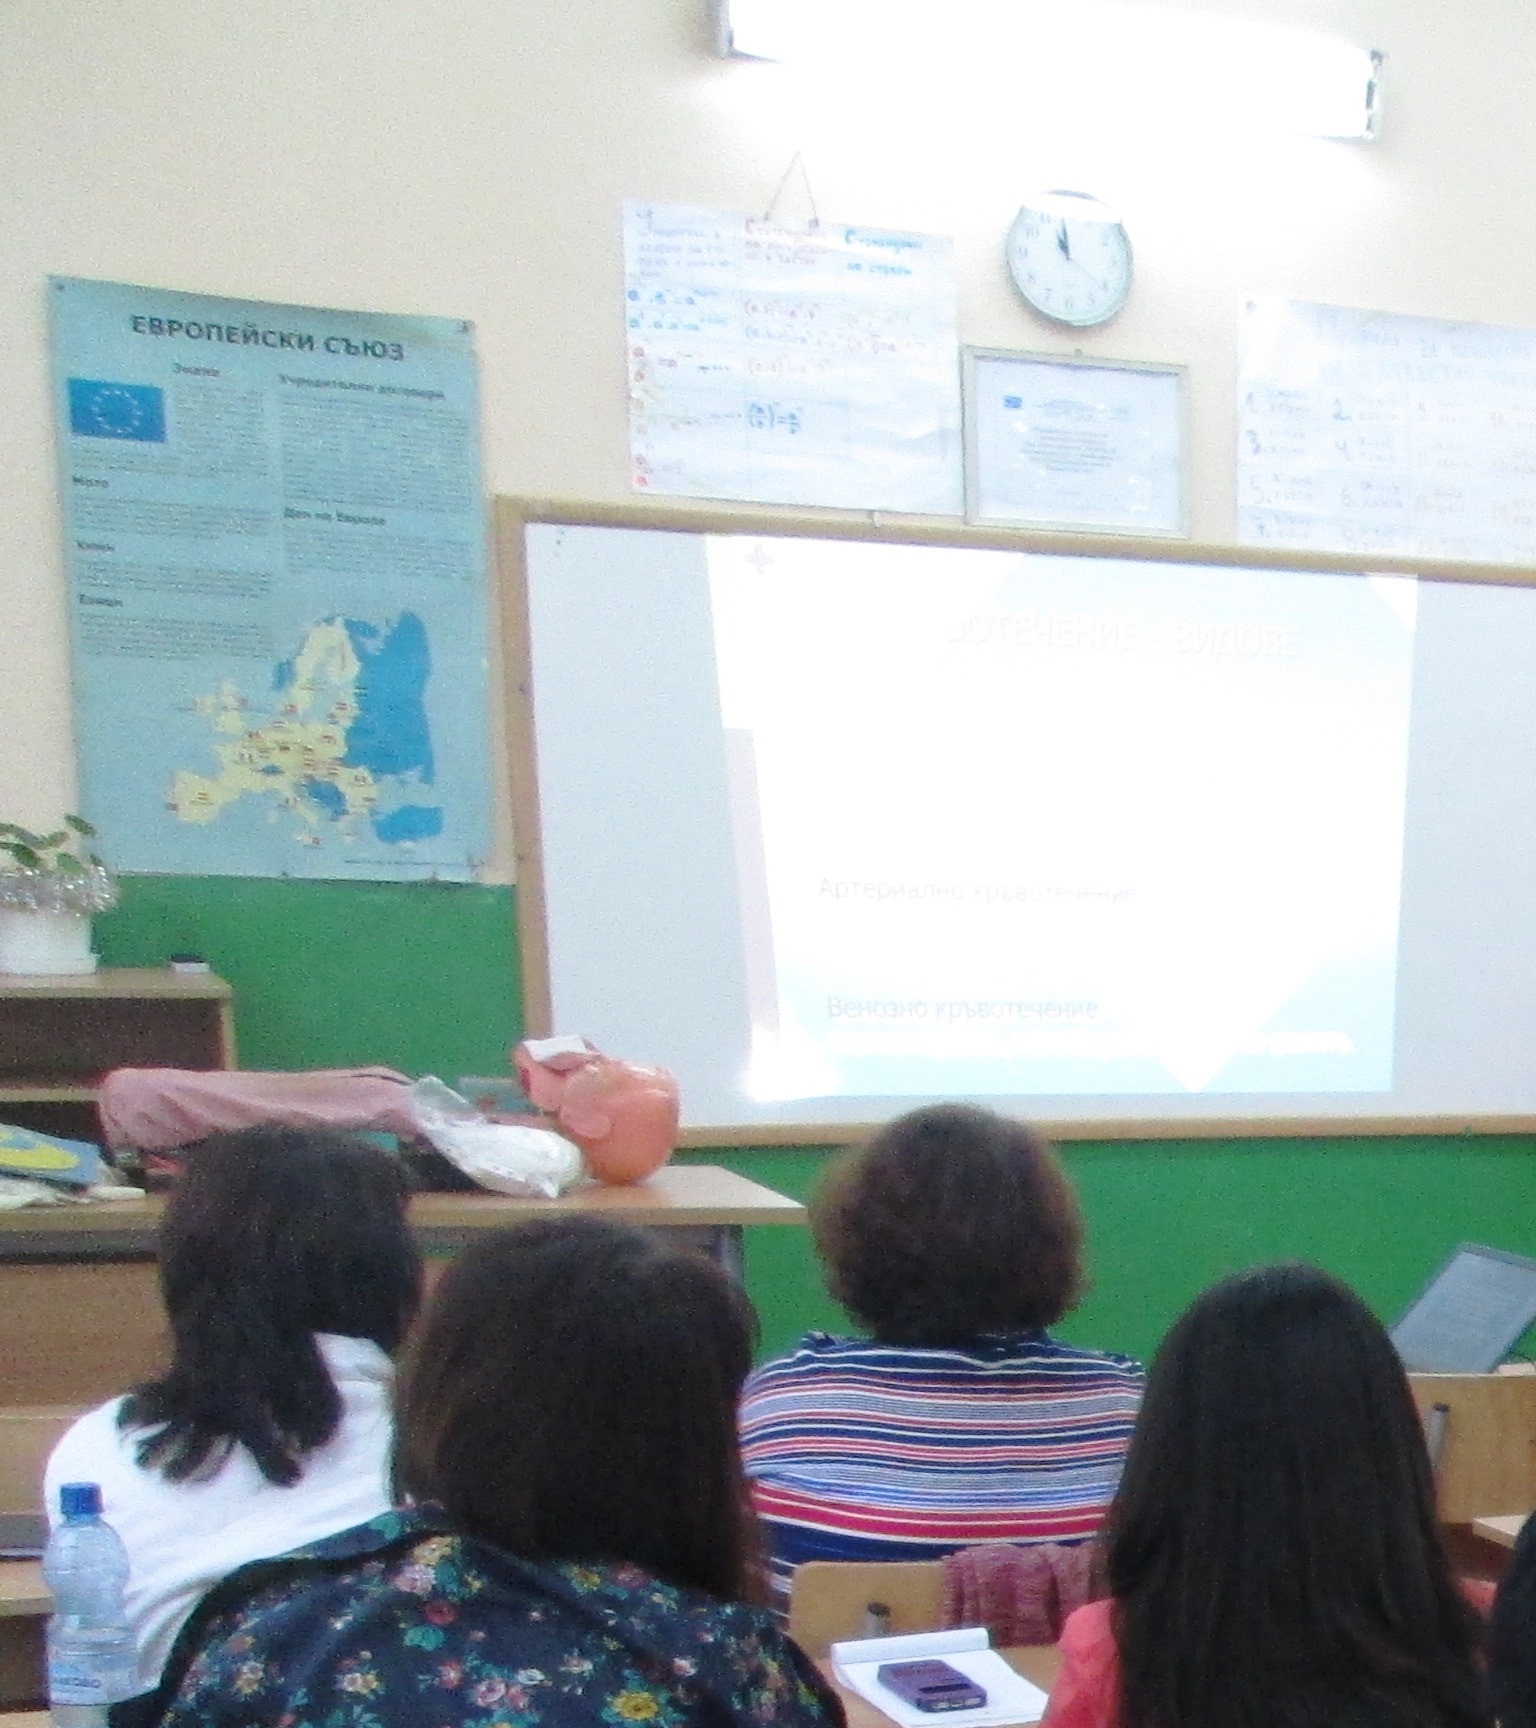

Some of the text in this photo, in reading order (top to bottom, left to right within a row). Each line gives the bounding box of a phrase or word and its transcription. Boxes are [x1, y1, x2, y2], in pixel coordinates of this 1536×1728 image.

[131, 314, 405, 362] ЕВРОПЕЙСКИ СЪЮЗ
[1173, 623, 1300, 662] ВИДОВЕ
[818, 876, 964, 903] Артериално
[826, 995, 1099, 1024] Венозно кръвотечение
